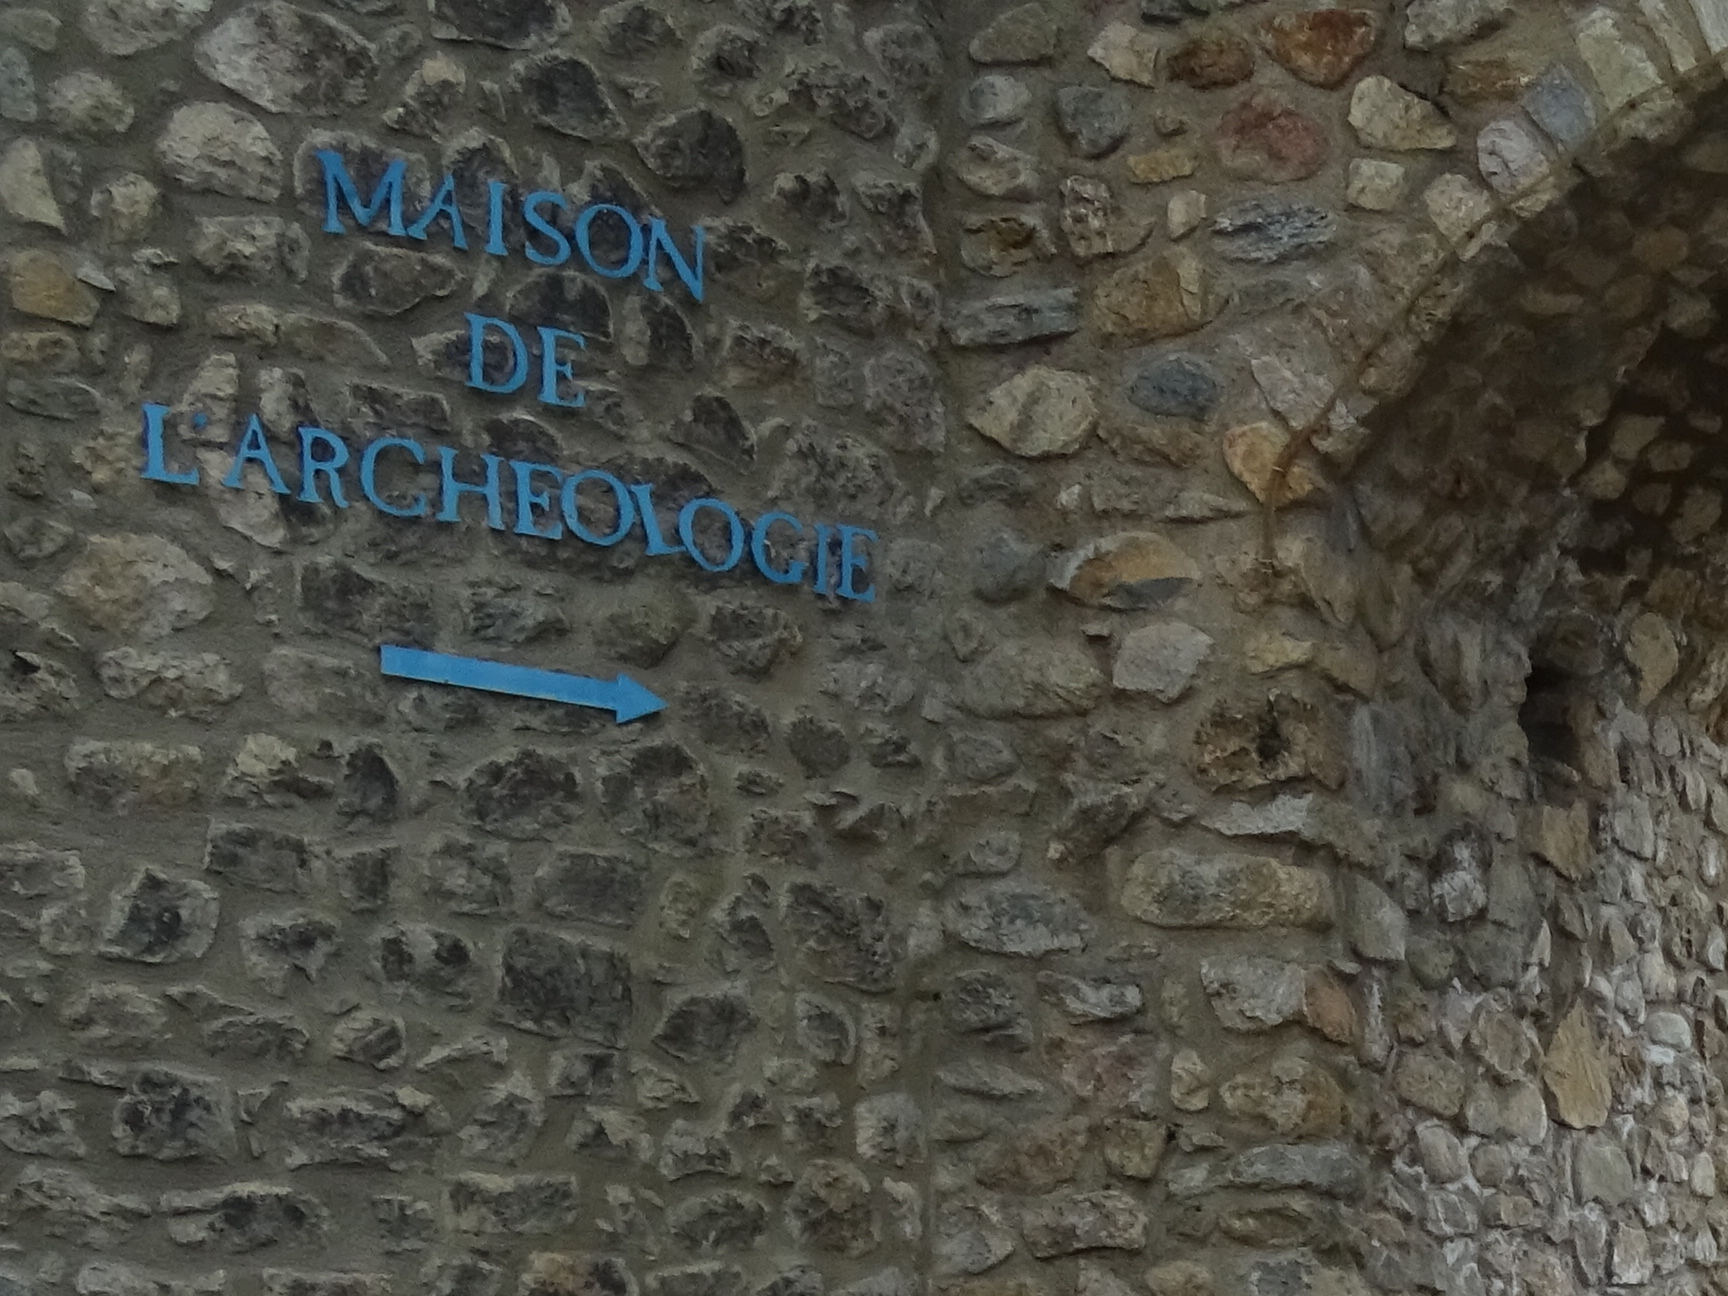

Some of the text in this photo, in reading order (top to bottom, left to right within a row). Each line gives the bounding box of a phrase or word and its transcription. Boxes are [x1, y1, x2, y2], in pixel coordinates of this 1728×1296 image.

[317, 150, 706, 302] MAISON
[463, 312, 586, 407] DE
[140, 403, 879, 601] L'ARCHEOLOGIE
